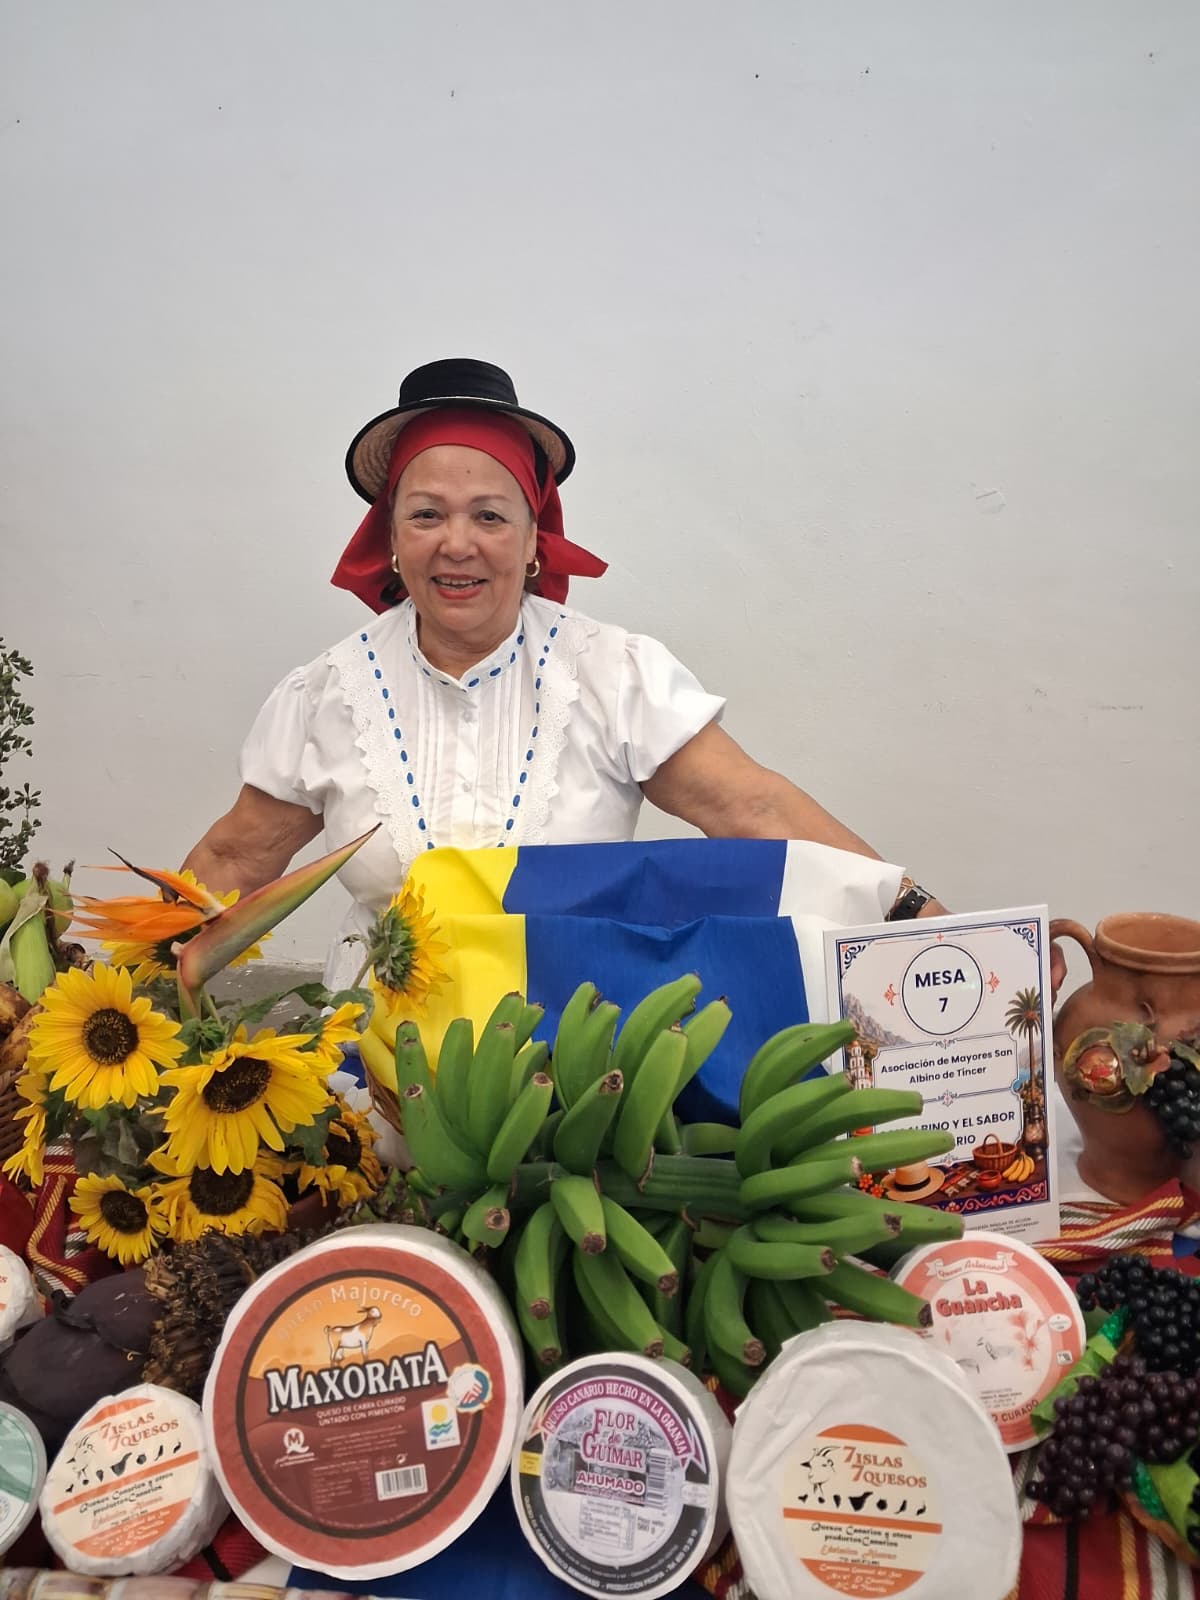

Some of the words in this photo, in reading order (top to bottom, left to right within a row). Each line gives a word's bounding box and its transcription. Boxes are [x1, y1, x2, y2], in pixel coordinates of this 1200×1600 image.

[915, 968, 966, 988] MESA
[938, 997, 949, 1013] 7
[881, 1059, 935, 1074] Asociación
[937, 1056, 949, 1065] de
[951, 1051, 992, 1064] Mayores
[995, 1048, 1013, 1058] San
[909, 1073, 940, 1084] Albino
[943, 1070, 954, 1079] de
[952, 1119, 960, 1129] Y
[962, 1117, 974, 1128] EL
[976, 1111, 1015, 1125] SABOR
[962, 1278, 988, 1296] La
[331, 1281, 423, 1317] Majorero
[936, 1291, 1023, 1317] Guancha
[266, 1342, 449, 1413] MAXORATA
[316, 1406, 341, 1418] QUESO
[342, 1405, 352, 1413] DE
[353, 1402, 375, 1412] CABRA
[376, 1396, 407, 1408] CURADO
[1001, 1399, 1039, 1422] CURADO
[319, 1414, 350, 1426] UNTADO
[350, 1411, 367, 1421] CON
[545, 1401, 568, 1431] QUESO
[567, 1384, 605, 1406] CANARIO
[605, 1382, 638, 1399] HECHO
[638, 1392, 651, 1407] EN
[650, 1401, 662, 1418] LA
[661, 1413, 688, 1454] GRANJA
[593, 1408, 636, 1435] FLOR
[607, 1430, 621, 1445] de
[576, 1471, 645, 1495] AHUMADO
[811, 1522, 842, 1532] Quesos
[846, 1526, 882, 1536] Canarios
[824, 1534, 861, 1543] productos
[862, 1537, 898, 1547] Canarios
